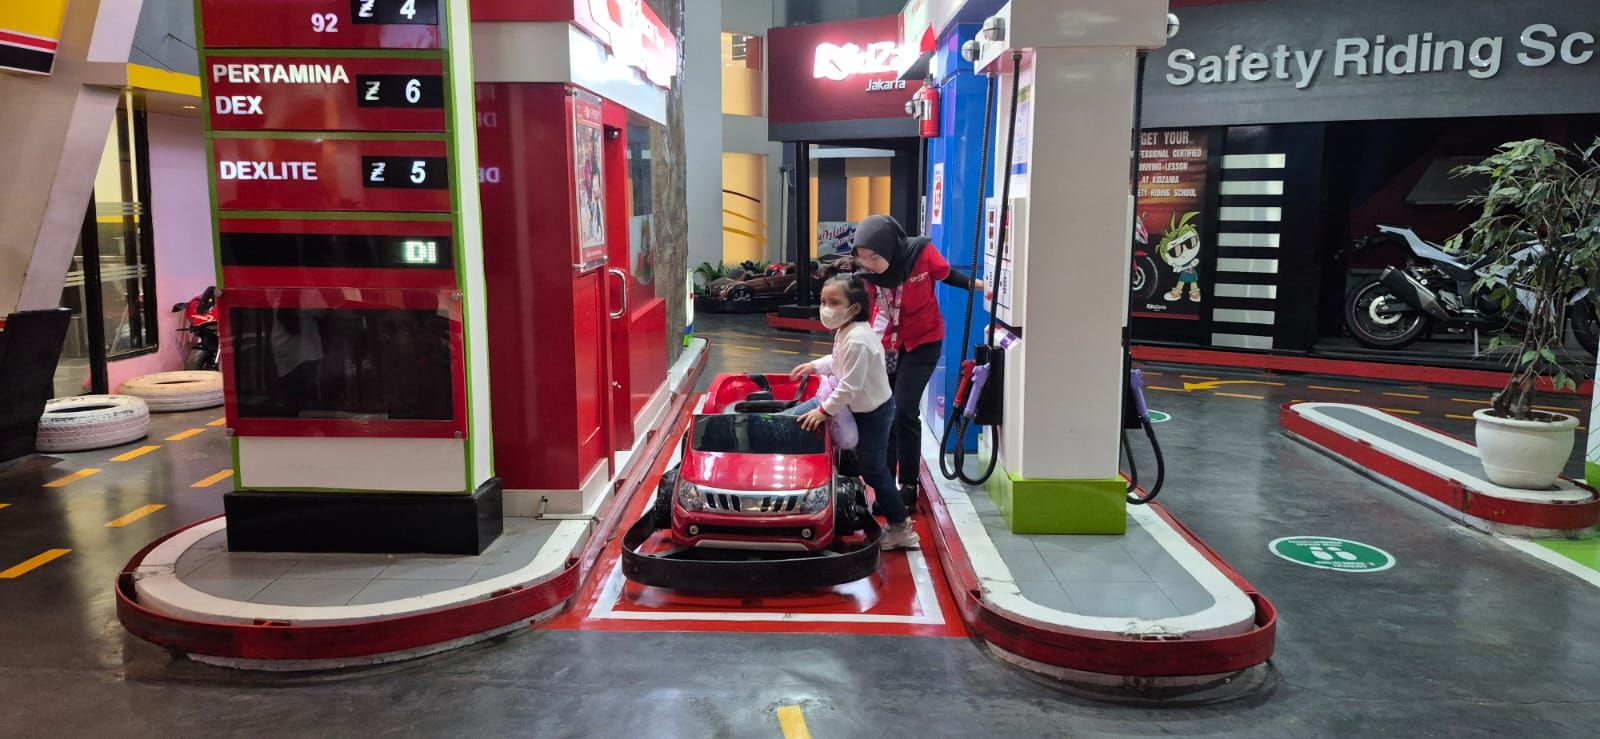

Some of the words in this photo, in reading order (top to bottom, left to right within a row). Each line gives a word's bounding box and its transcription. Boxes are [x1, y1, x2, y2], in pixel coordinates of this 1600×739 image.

[400, 0, 416, 20] 4
[311, 13, 338, 33] 92
[1166, 44, 1324, 89] Safety
[1334, 32, 1503, 79] Riding
[1517, 23, 1595, 67] Sc
[212, 64, 350, 84] PERTAMINA
[405, 78, 421, 104] 6
[866, 78, 906, 91] Jakarta
[215, 95, 264, 115] DEX
[1141, 132, 1158, 146] GET
[1164, 131, 1189, 145] YOUR
[1172, 148, 1202, 158] CERTIFIED
[220, 160, 318, 180] DEXLITE
[410, 160, 426, 184] 5
[1165, 162, 1188, 171] LESSON
[1142, 175, 1150, 184] AT
[1151, 188, 1171, 197] RIDING
[1174, 188, 1197, 197] SCHOOL
